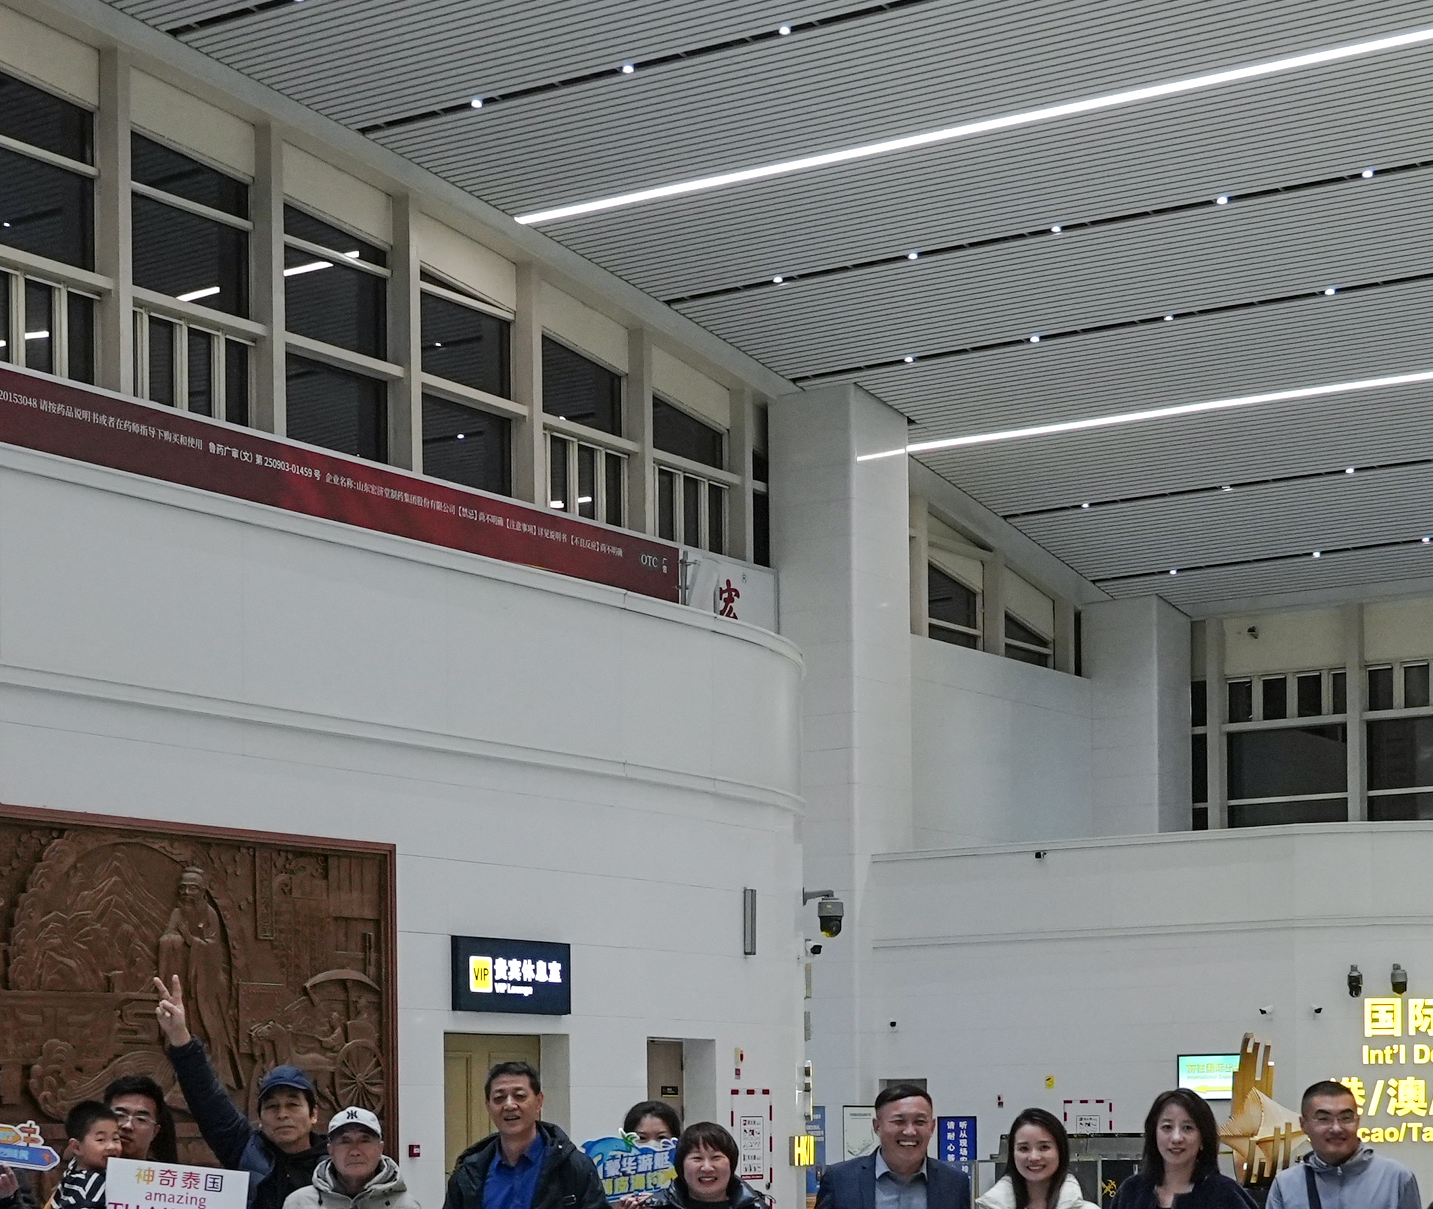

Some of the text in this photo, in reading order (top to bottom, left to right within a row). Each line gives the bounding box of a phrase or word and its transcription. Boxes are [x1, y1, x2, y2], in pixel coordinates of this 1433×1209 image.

[640, 553, 659, 568] OTC
[473, 967, 490, 982] VIP
[493, 957, 562, 983] 贵宾休息室
[1361, 1044, 1406, 1066] Int'l
[1186, 1063, 1236, 1073] 前往国际出
[135, 1166, 224, 1193] 神奇泰国
[145, 1191, 207, 1209] amazing
